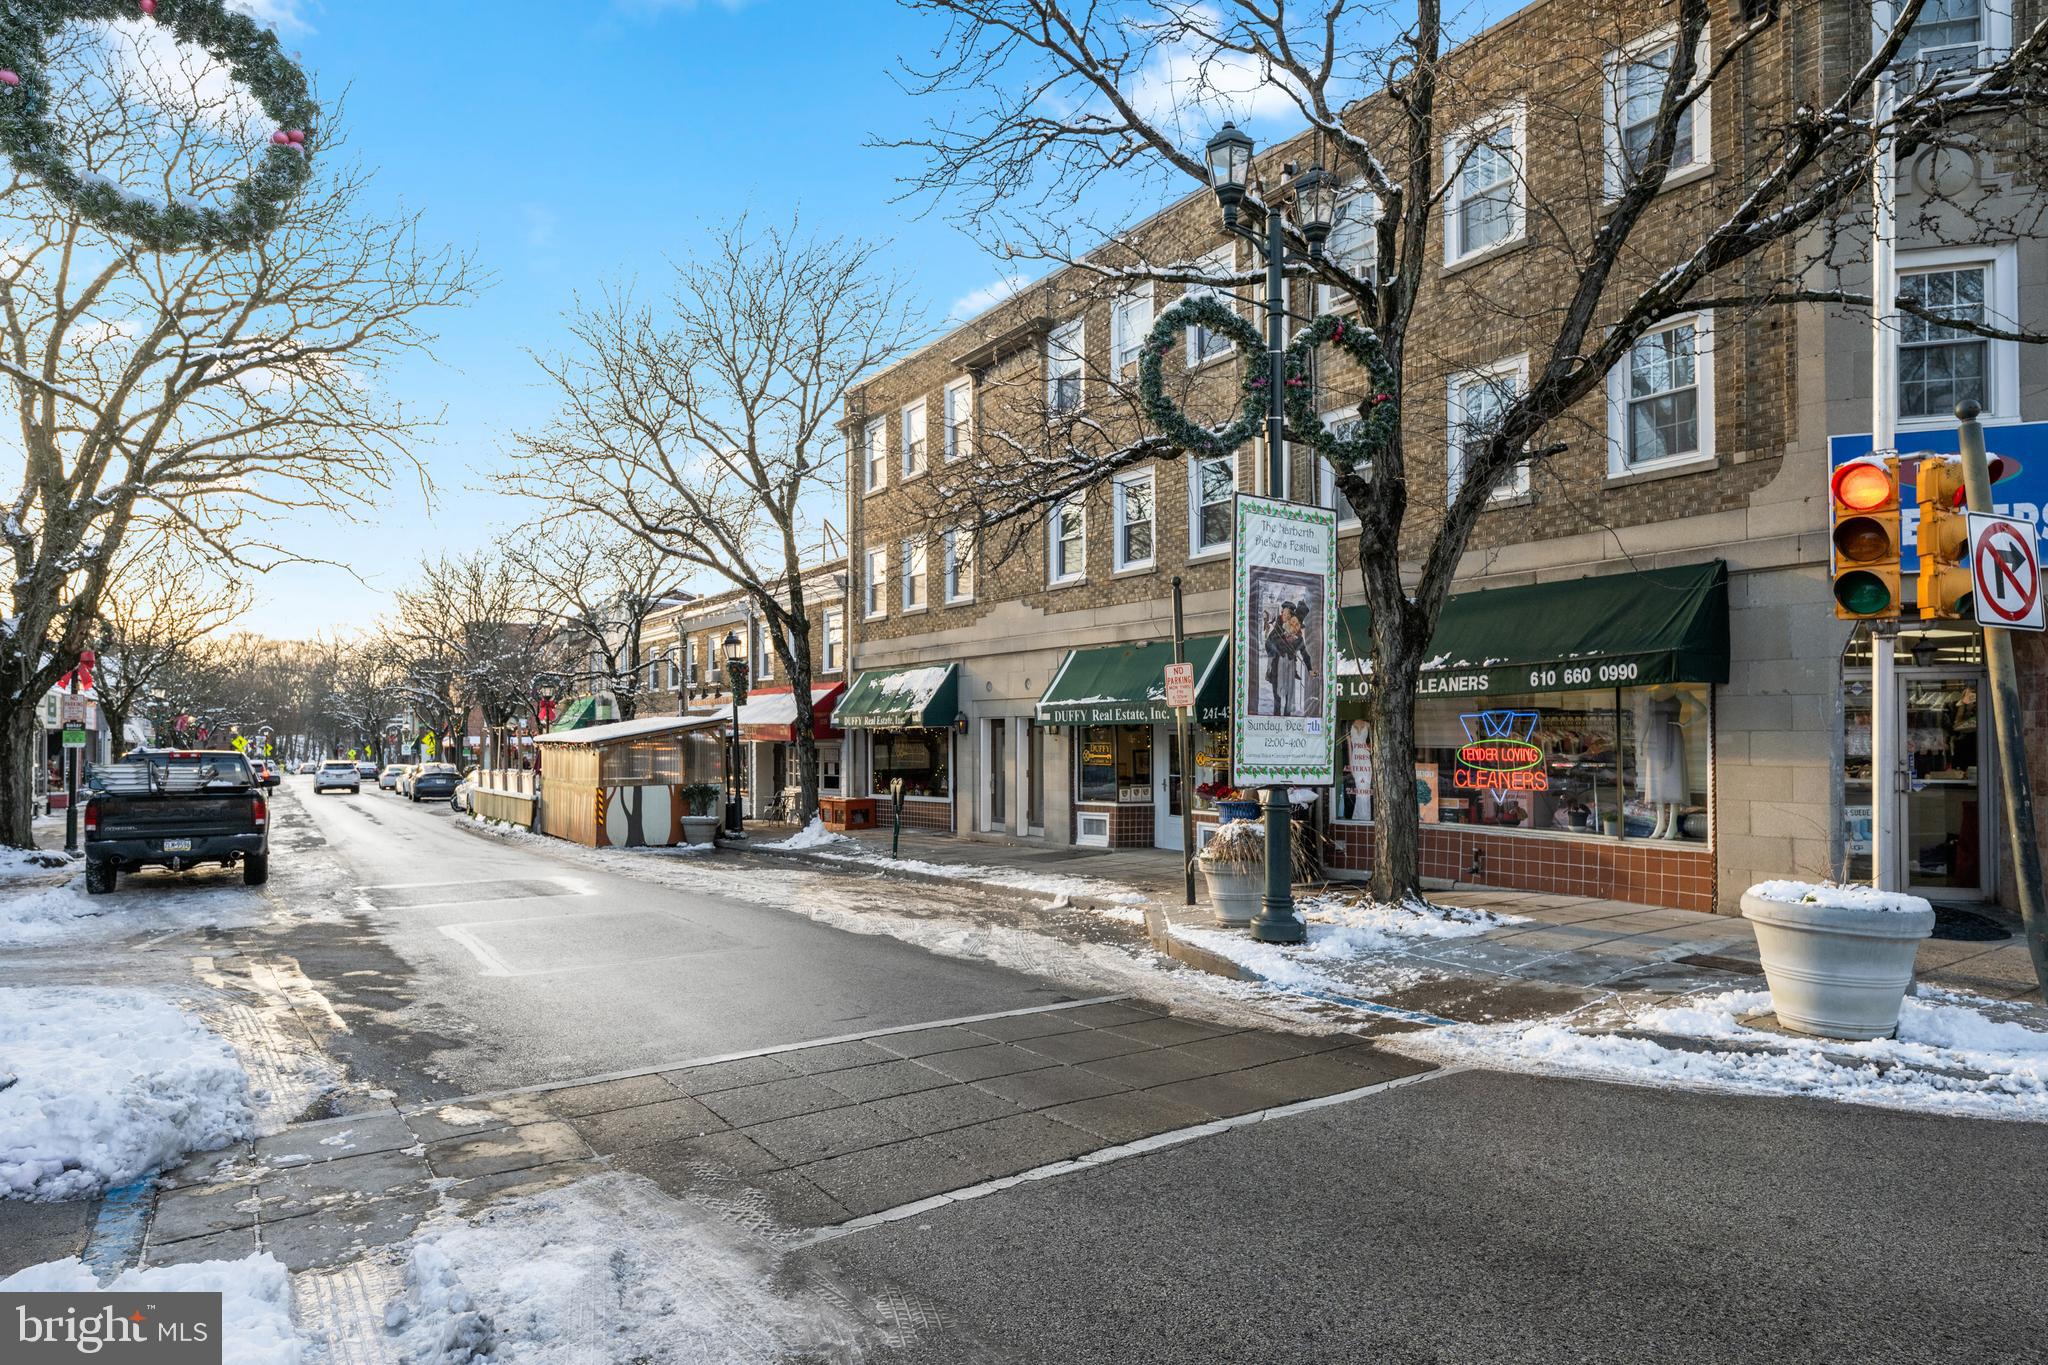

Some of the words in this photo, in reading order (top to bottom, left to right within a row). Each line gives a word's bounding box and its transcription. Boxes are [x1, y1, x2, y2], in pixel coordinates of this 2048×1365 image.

[1261, 519, 1276, 533] The
[1255, 535, 1288, 550] Dickens
[1289, 540, 1320, 554] Festival
[1271, 552, 1305, 567] Returns!
[1173, 666, 1184, 675] NO
[1530, 670, 1556, 687] 610
[1564, 667, 1591, 684] 660
[1599, 663, 1638, 682] 0990
[1168, 676, 1192, 685] PARKING
[844, 716, 863, 726] DUFFY
[864, 715, 875, 725] Real
[1054, 709, 1088, 722] DUFFY
[1092, 708, 1113, 722] Real
[1115, 708, 1148, 722] Estate,
[1150, 707, 1170, 720] Inc.
[1307, 719, 1320, 732] 7th
[1264, 737, 1307, 748] 12:00-4:00
[1462, 747, 1498, 761] TENDER
[1501, 747, 1539, 762] LOVING
[1454, 769, 1548, 791] CLEANERS
